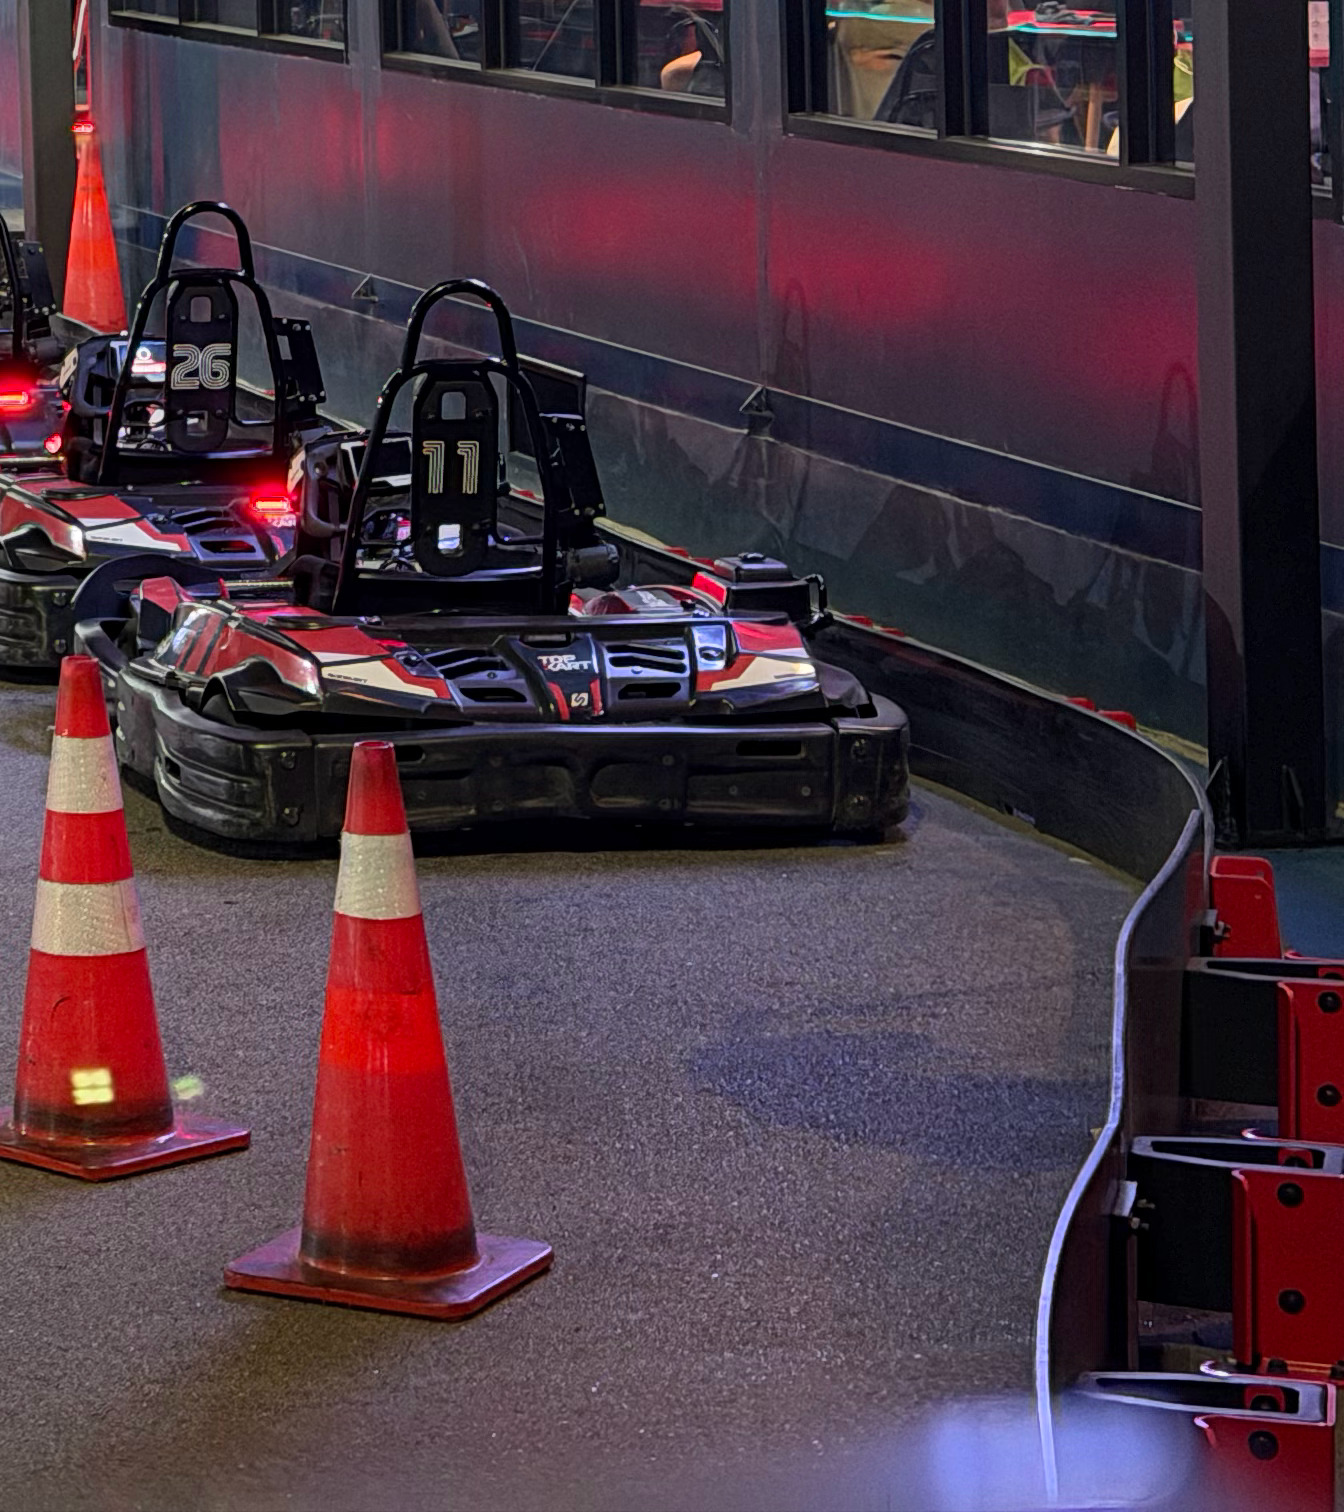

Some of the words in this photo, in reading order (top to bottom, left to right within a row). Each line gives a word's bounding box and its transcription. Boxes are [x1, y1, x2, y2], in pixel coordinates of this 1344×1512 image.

[171, 343, 232, 390] 26
[422, 441, 480, 495] 11
[537, 654, 576, 665] TOP
